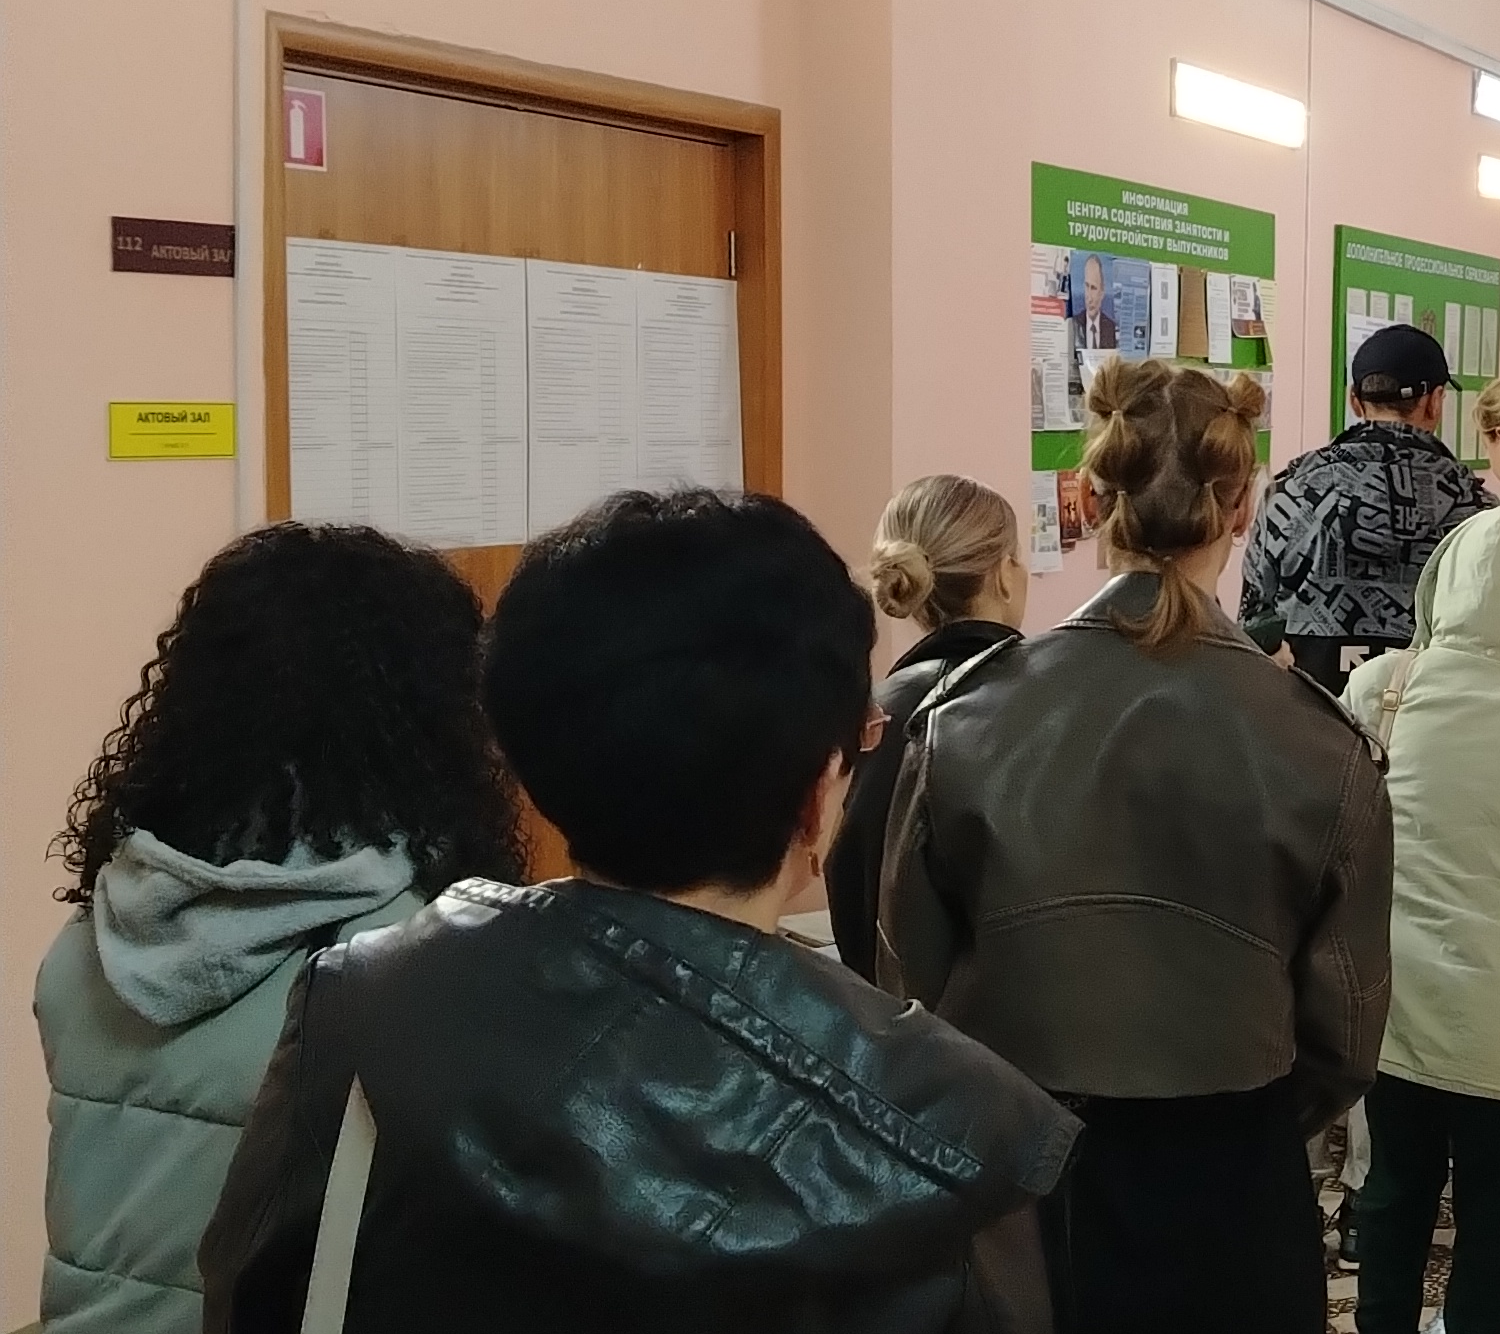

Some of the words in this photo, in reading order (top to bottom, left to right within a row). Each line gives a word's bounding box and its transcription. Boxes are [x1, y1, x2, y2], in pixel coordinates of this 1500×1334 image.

[1122, 190, 1188, 216] ИНФОРМАЦИЯ
[1067, 200, 1109, 220] ЦЕНТРА
[1111, 208, 1173, 232] СОДЕЙСТВИЯ
[1175, 220, 1223, 242] ЗАНЯТОСТИ
[1223, 230, 1230, 243] И
[117, 237, 143, 251] 112
[151, 245, 210, 262] АКТОВЫЙ
[1068, 222, 1165, 249] ТРУДОУСТРОЙСТВУ
[1166, 238, 1229, 260] ВЫПУСКНИКОВ
[137, 410, 188, 423] АКТОВЫЙ
[190, 412, 210, 423] ЗАЛ
